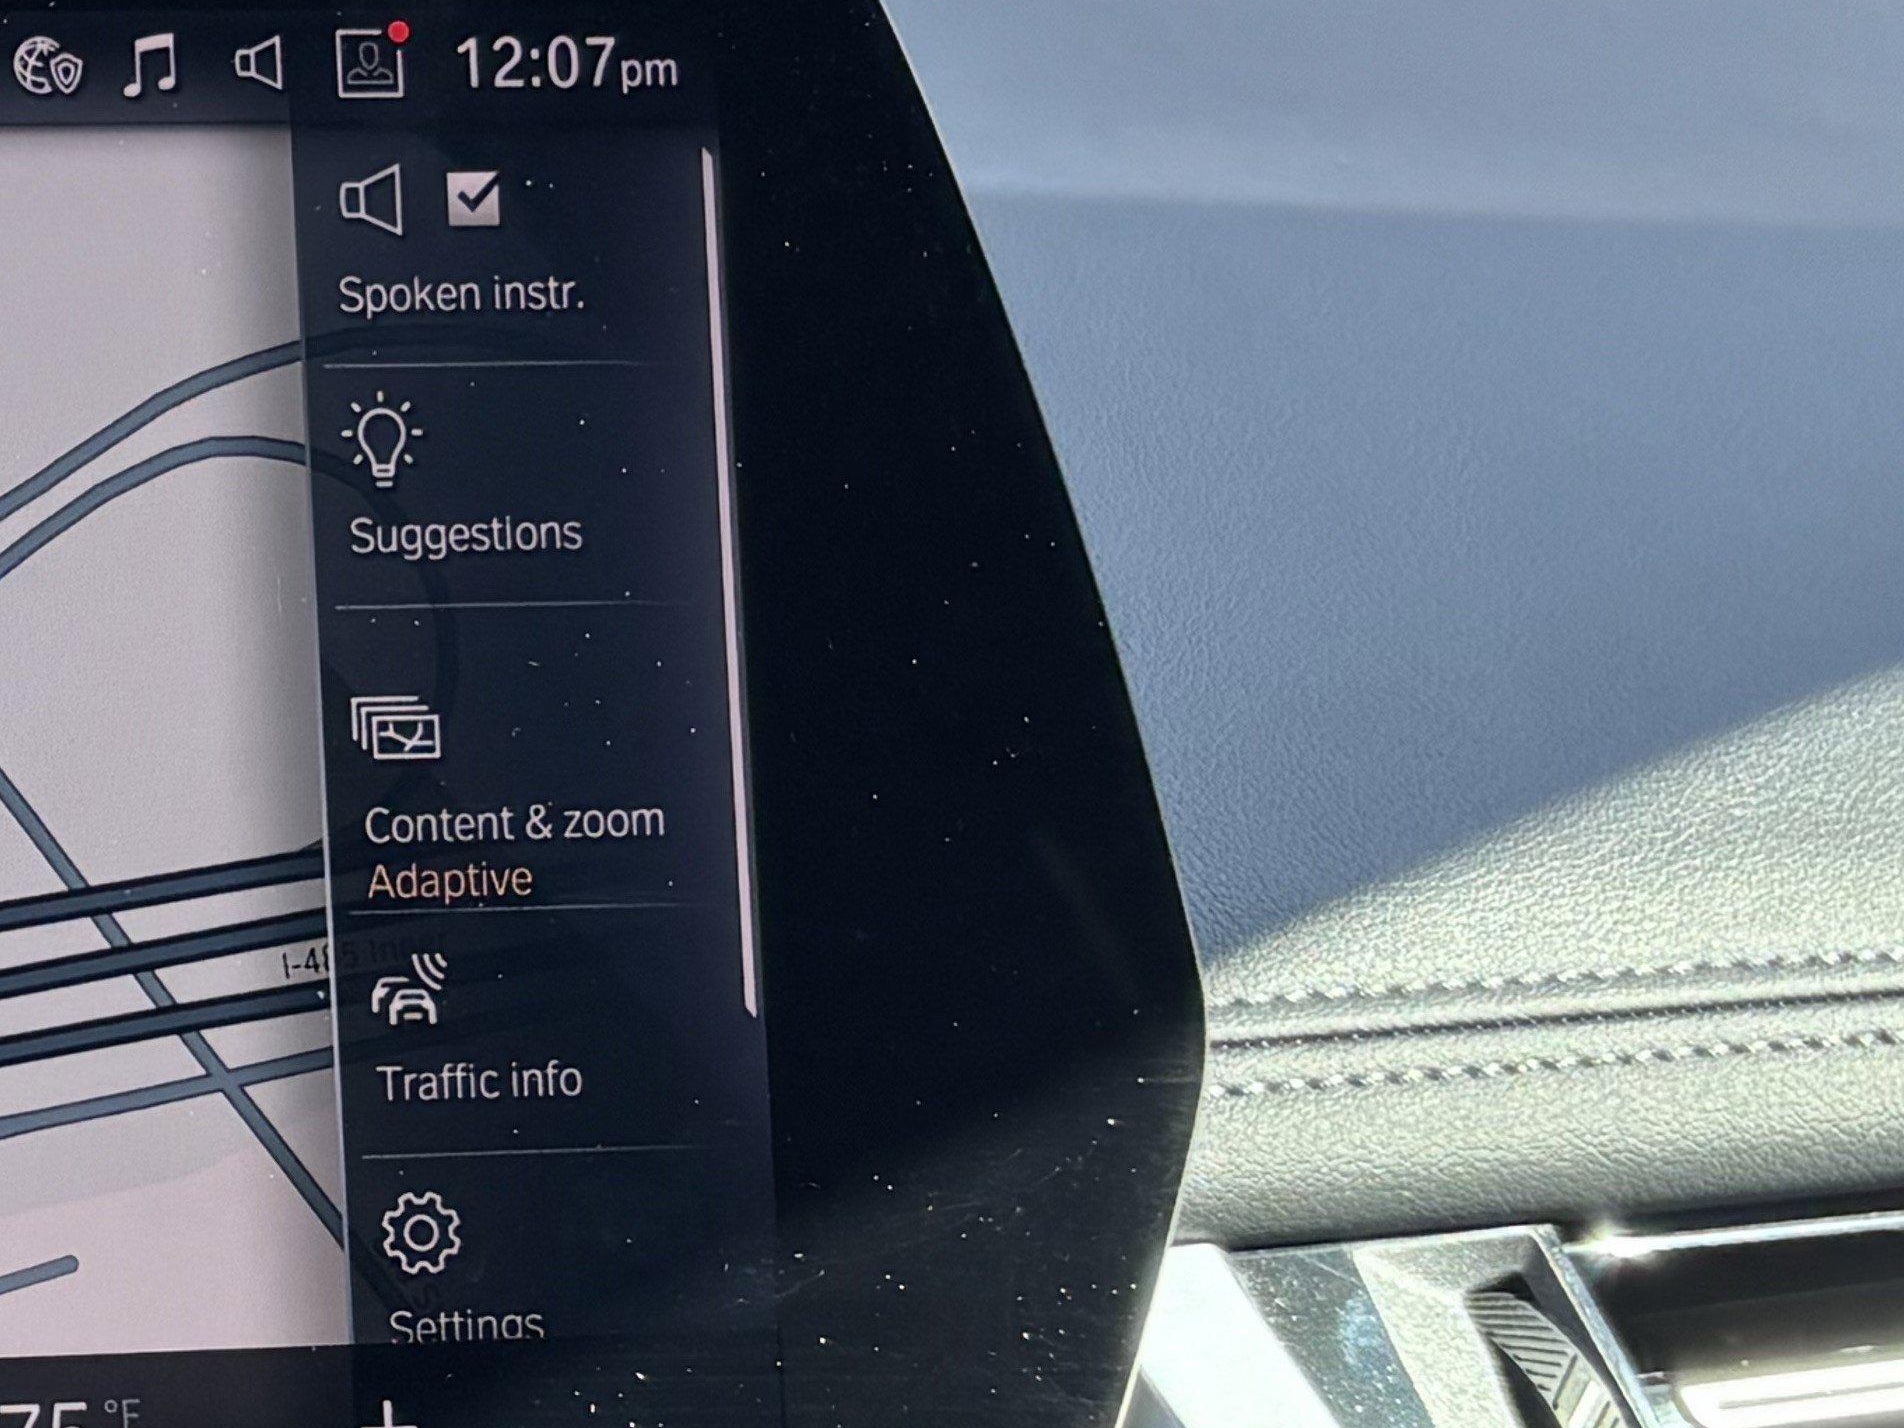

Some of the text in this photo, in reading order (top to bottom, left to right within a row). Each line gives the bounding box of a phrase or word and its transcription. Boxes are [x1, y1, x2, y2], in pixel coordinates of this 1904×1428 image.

[456, 34, 678, 93] 12:07pm
[338, 274, 585, 317] Spoken instr.
[349, 514, 584, 558] Suggestions
[364, 803, 666, 845] Content & zoom
[367, 861, 534, 904] Adaptive
[375, 1058, 583, 1102] Traffic info
